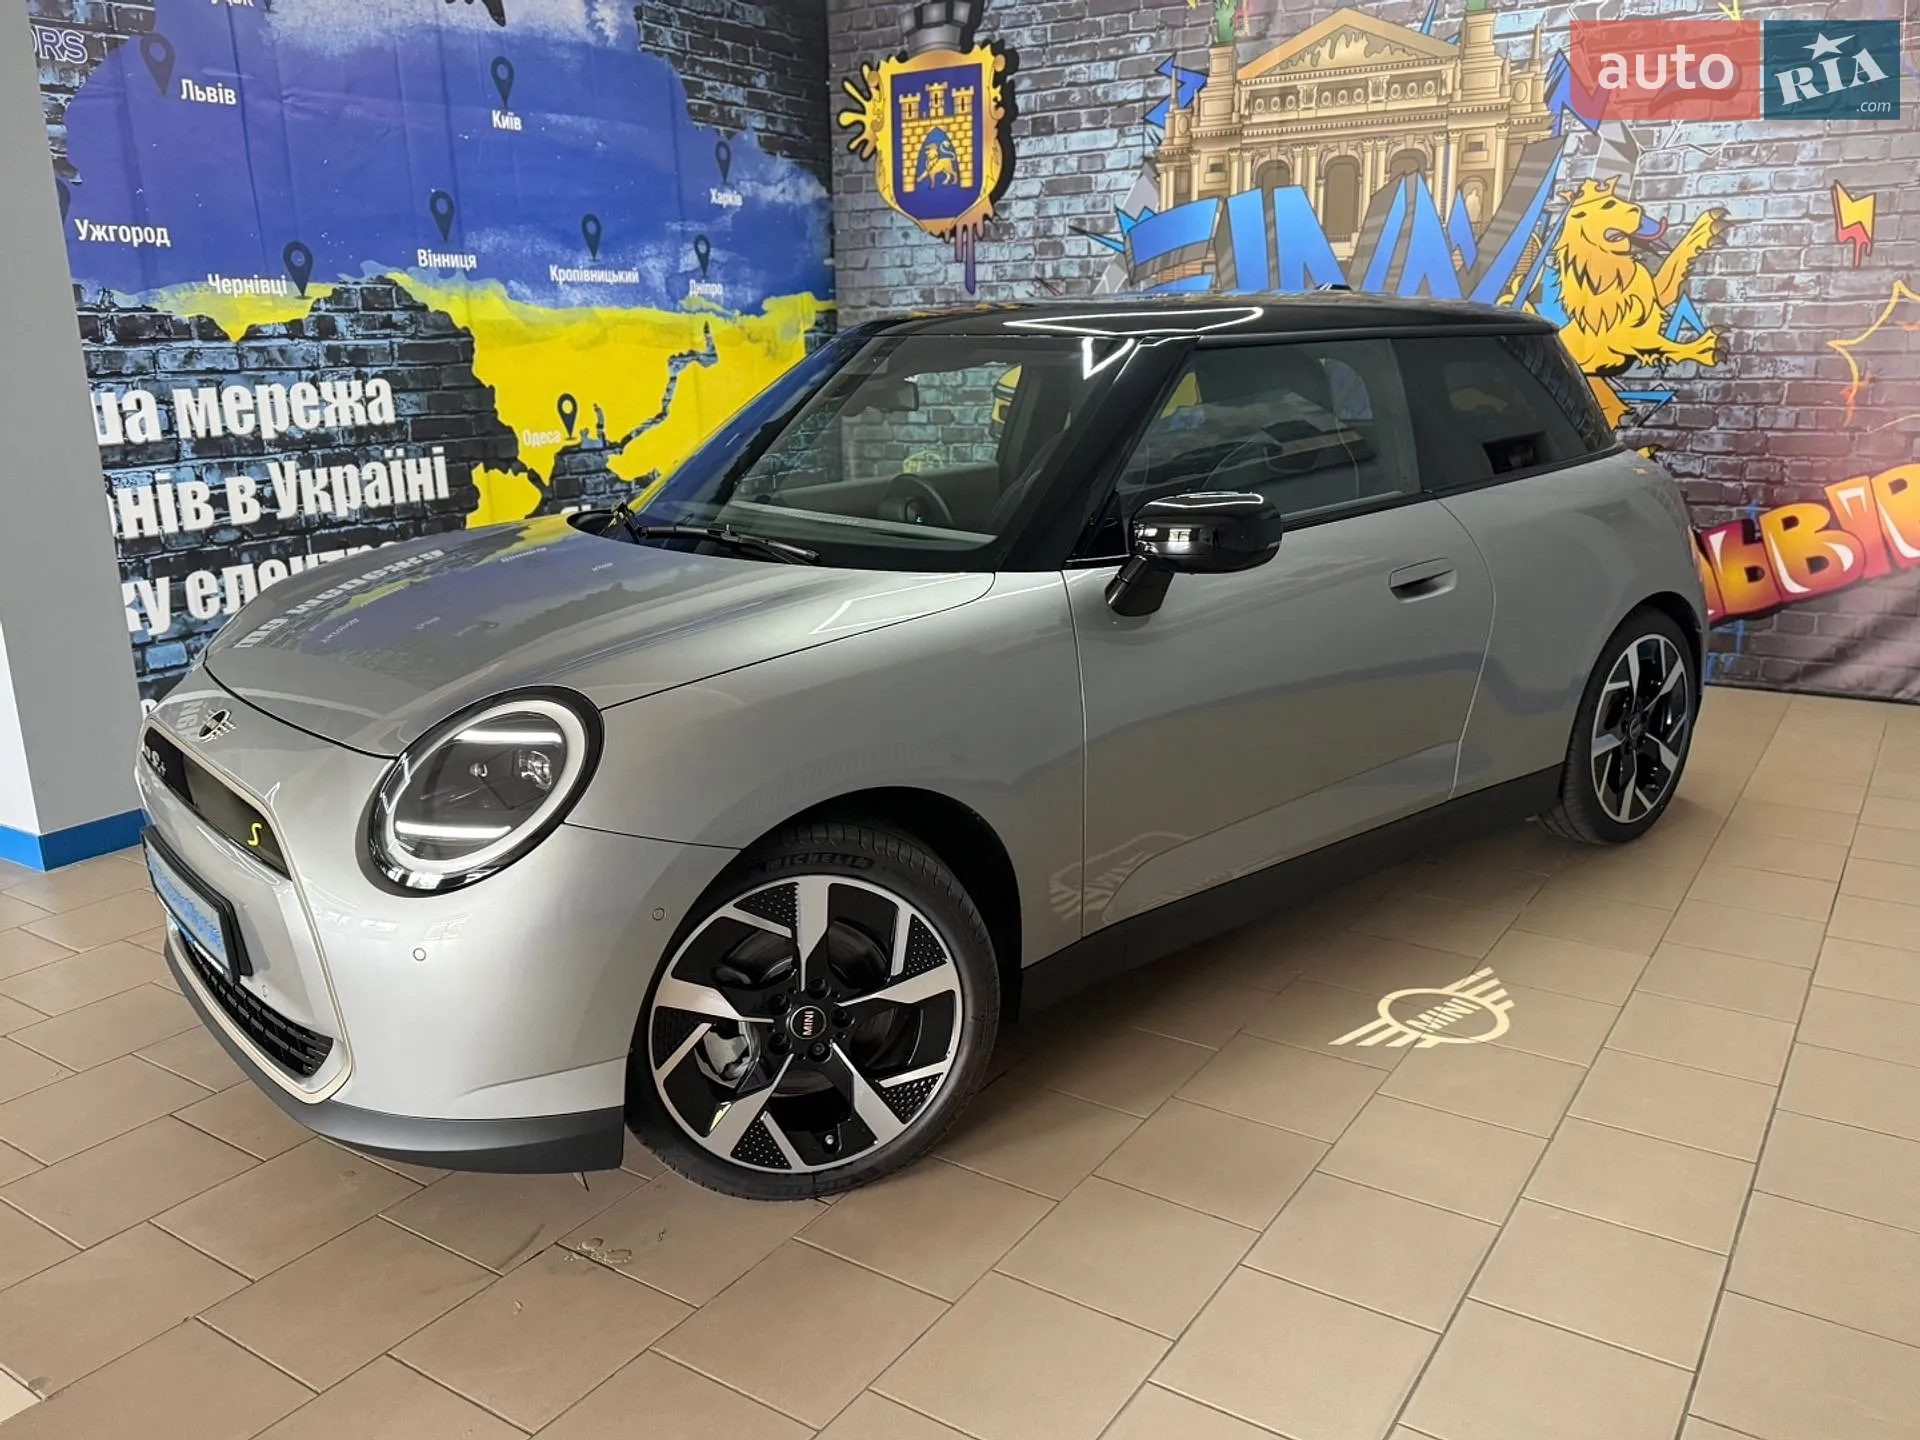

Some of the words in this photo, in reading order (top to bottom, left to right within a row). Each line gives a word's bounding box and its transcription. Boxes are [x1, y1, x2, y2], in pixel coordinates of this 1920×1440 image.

[31, 26, 88, 64] RS
[181, 79, 236, 106] Львів
[491, 110, 523, 132] Київ
[74, 218, 172, 247] Ужгород
[417, 249, 477, 271] Вінниця
[207, 273, 288, 297] Чернівці
[549, 264, 640, 286] Кропівницький
[172, 377, 396, 441] мережа
[522, 429, 561, 447] Одеса
[106, 473, 215, 540] нів
[225, 475, 262, 526] в
[267, 446, 451, 519] Україні
[802, 1010, 815, 1036] MINI
[1405, 997, 1482, 1033] MINI
